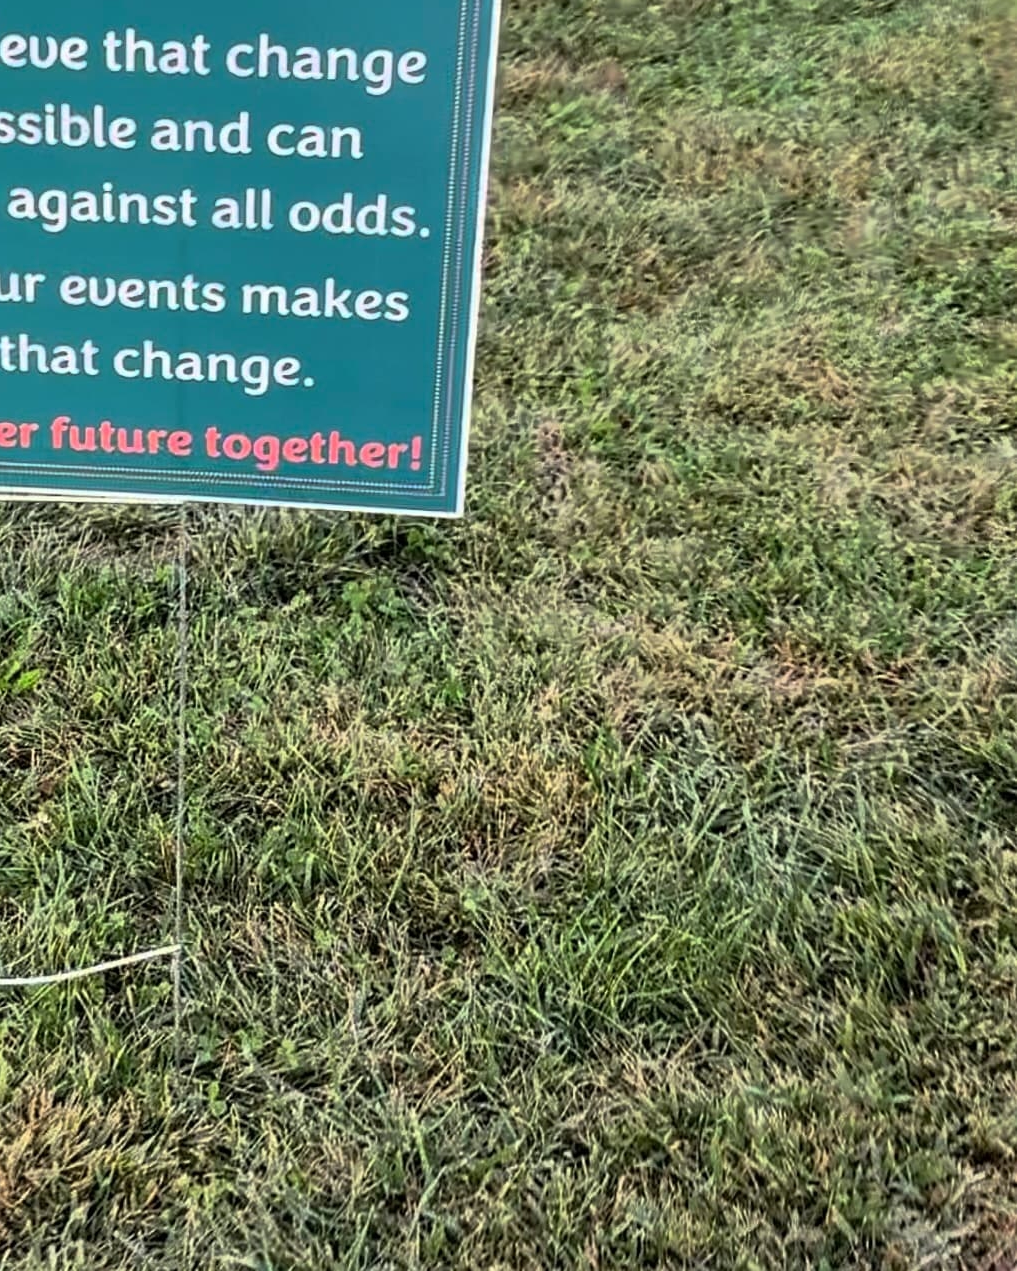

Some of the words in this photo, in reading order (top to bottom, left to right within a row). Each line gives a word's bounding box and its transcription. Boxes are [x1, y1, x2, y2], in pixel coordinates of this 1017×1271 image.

[102, 28, 210, 76] that
[226, 33, 427, 96] change
[150, 111, 252, 154] and
[267, 124, 364, 159] can
[7, 182, 197, 233] against
[211, 188, 273, 230] all
[289, 192, 430, 238] odds.
[59, 274, 226, 313] events
[242, 277, 409, 322] makes
[113, 340, 314, 396] change.
[49, 415, 193, 457] future
[204, 426, 422, 472] together!
